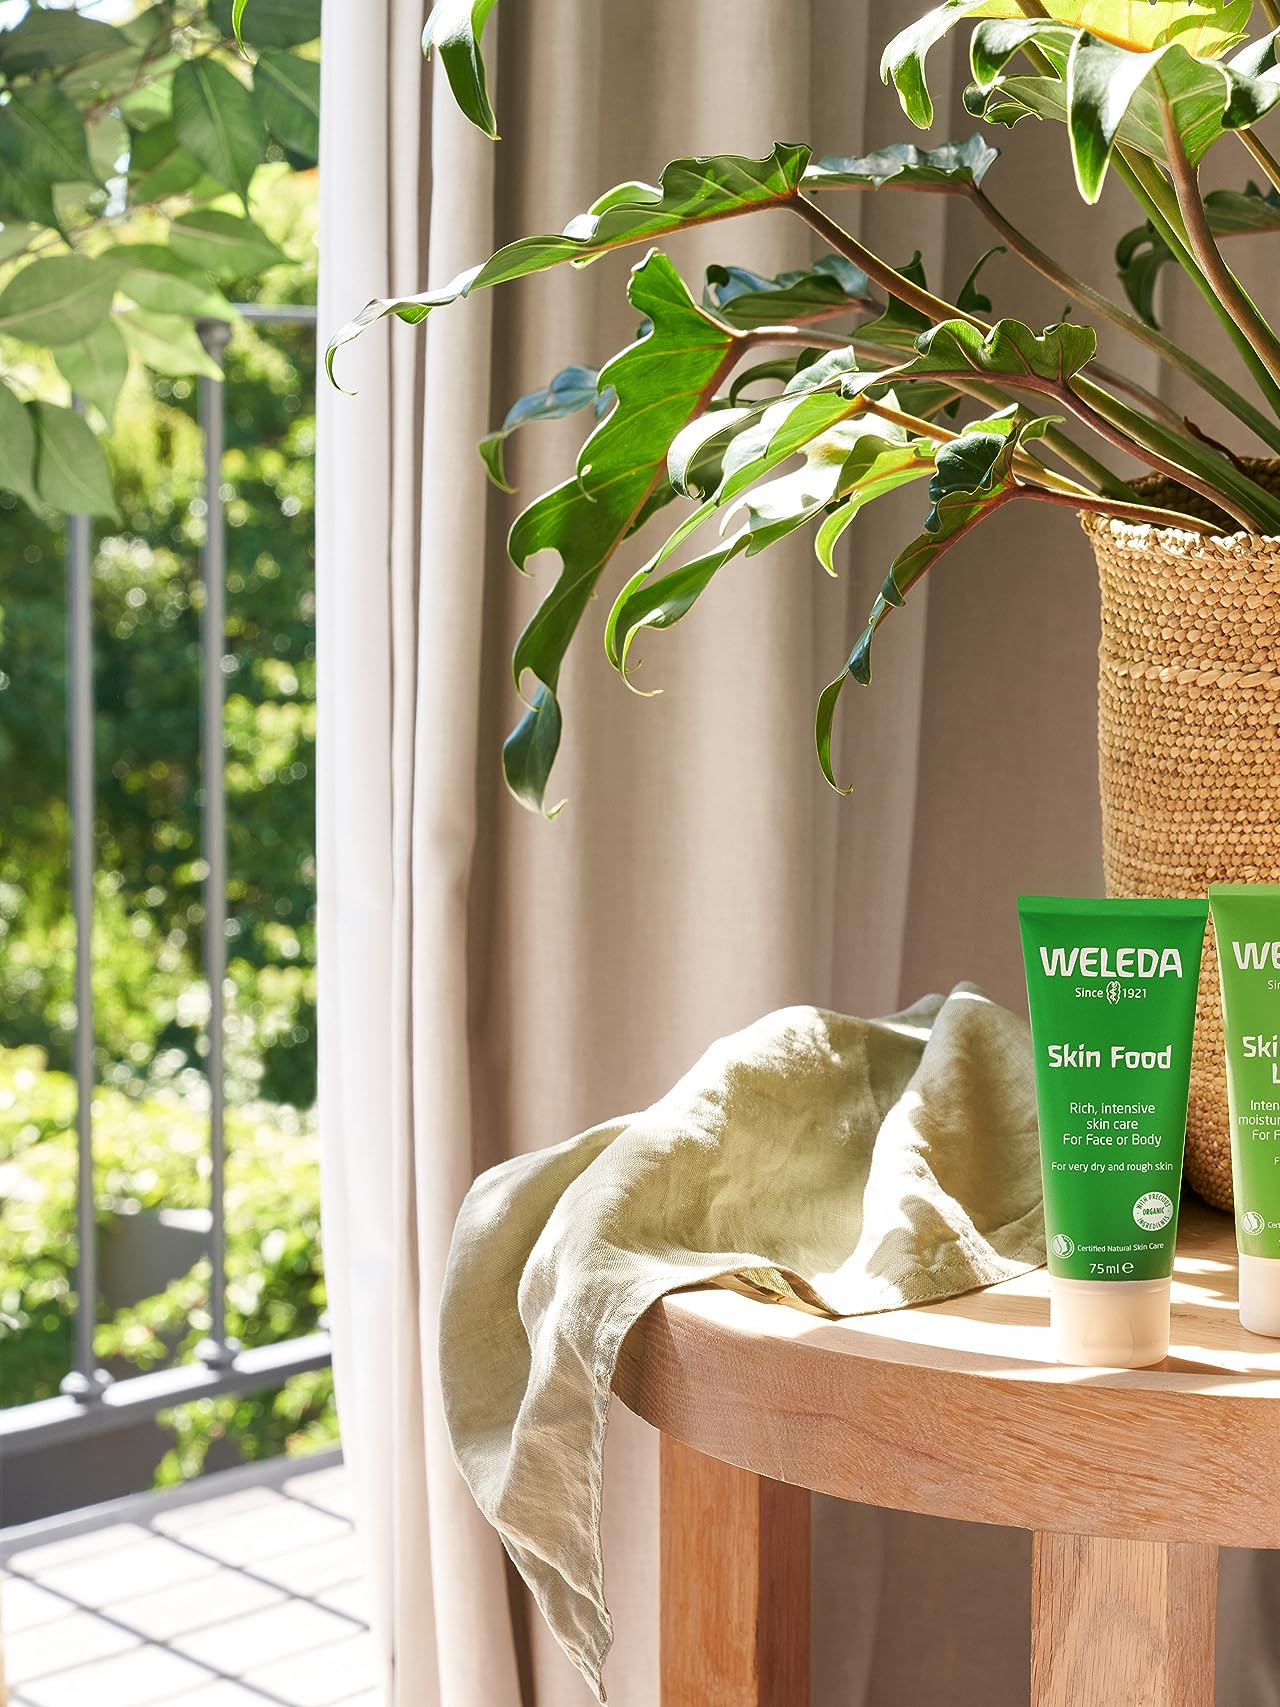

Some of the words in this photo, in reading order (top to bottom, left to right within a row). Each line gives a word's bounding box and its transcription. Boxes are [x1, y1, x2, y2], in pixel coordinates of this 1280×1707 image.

[1040, 947, 1183, 978] WELEDA
[1075, 988, 1103, 998] Since
[1123, 989, 1147, 998] 1921
[1048, 1043, 1100, 1068] Skin
[1111, 1045, 1172, 1069] Food
[1070, 1103, 1098, 1115] Rich,
[1101, 1103, 1155, 1114] intensive
[1087, 1119, 1109, 1130] skin
[1114, 1121, 1138, 1130] care
[1063, 1134, 1082, 1145] For
[1086, 1134, 1112, 1145] Face
[1117, 1136, 1128, 1145] or
[1132, 1134, 1161, 1147] Body
[1252, 1130, 1269, 1140] For
[1051, 1162, 1066, 1171] For
[1069, 1164, 1088, 1172] very
[1091, 1162, 1105, 1172] dry
[1108, 1162, 1124, 1171] and
[1127, 1161, 1152, 1172] rough
[1155, 1161, 1173, 1171] skin
[1136, 1197, 1147, 1209] WITH
[1149, 1194, 1170, 1207] PRECIOUS
[1143, 1207, 1165, 1215] ORGANIC
[1137, 1216, 1169, 1229] INGREDIENTS
[1078, 1244, 1105, 1252] Certified
[1108, 1244, 1131, 1252] Natural
[1133, 1243, 1147, 1251] Skin
